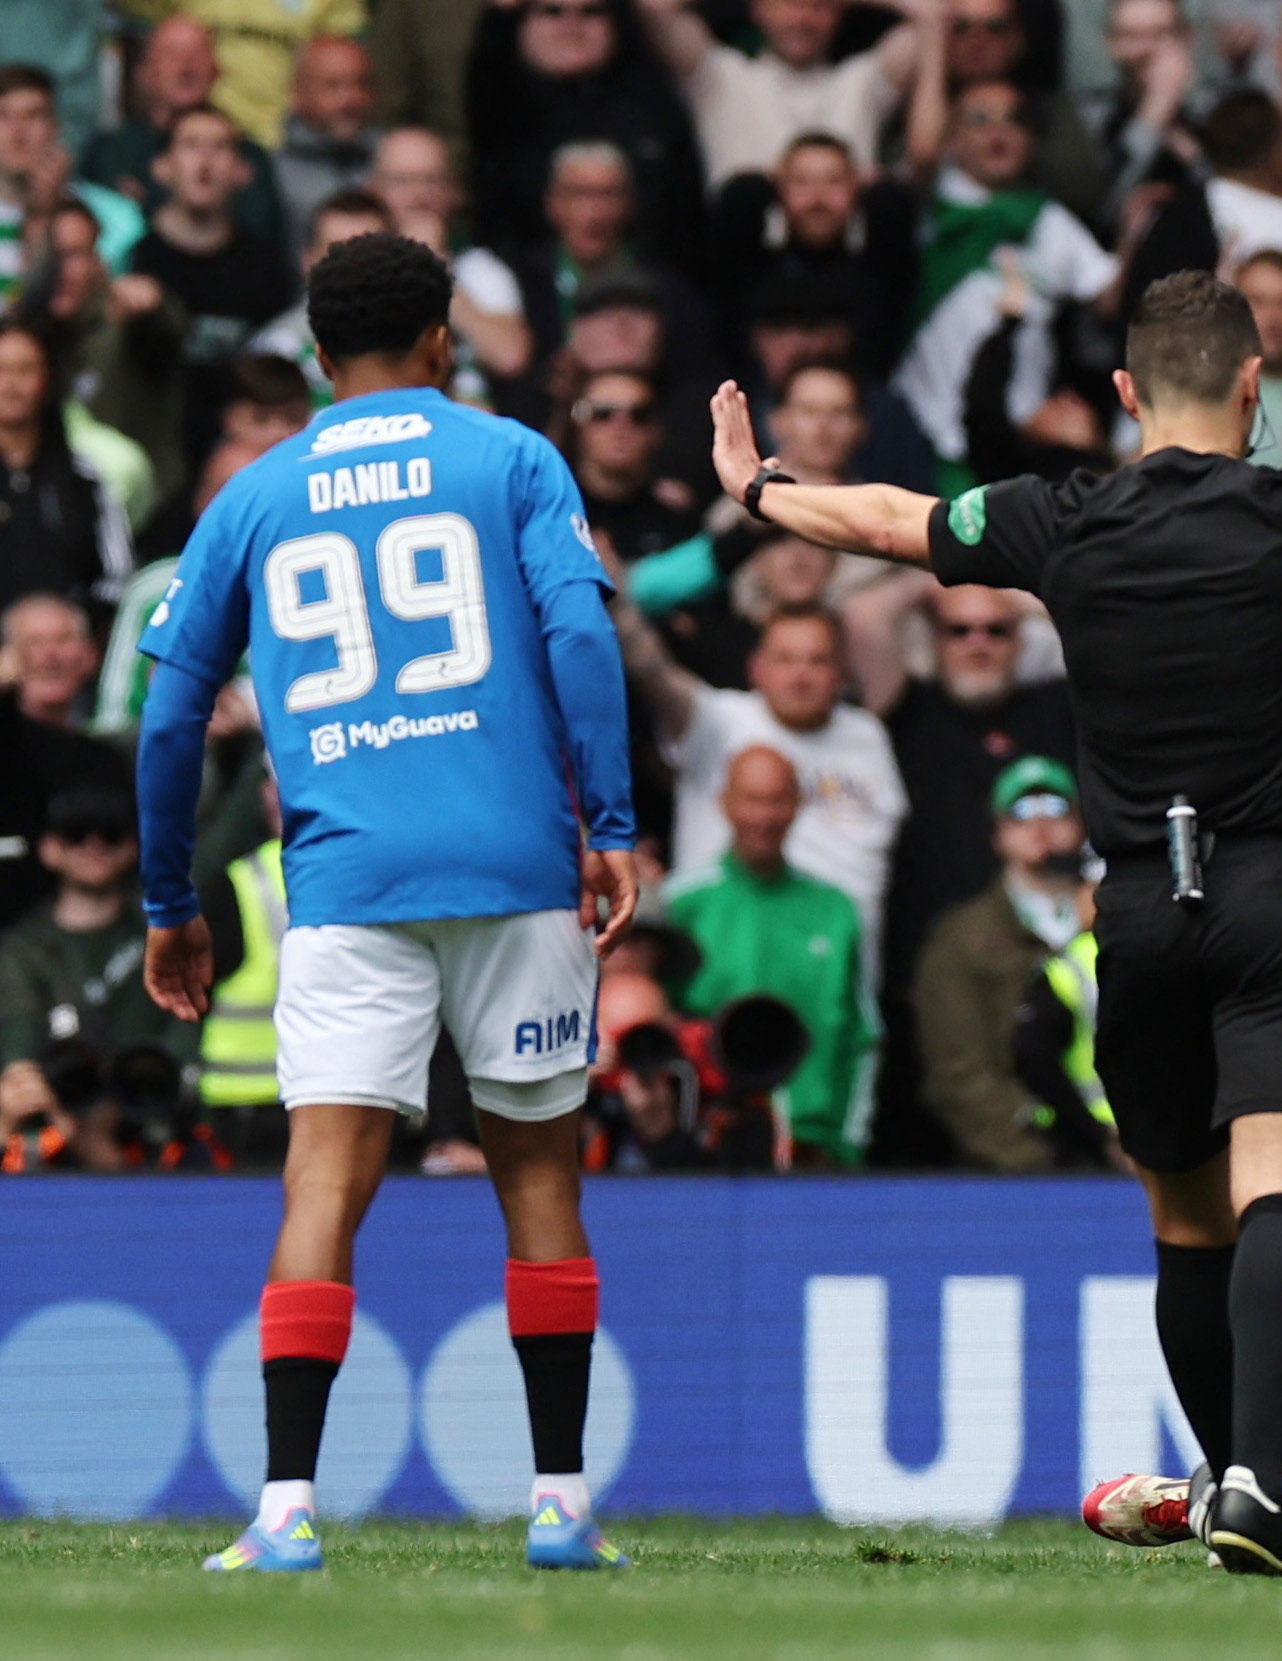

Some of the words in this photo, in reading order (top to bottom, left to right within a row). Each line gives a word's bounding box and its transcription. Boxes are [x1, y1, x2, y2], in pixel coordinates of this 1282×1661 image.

[308, 457, 432, 513] DANILO
[264, 511, 492, 714] 99
[348, 710, 479, 749] MyGuava
[515, 1009, 580, 1055] AIM
